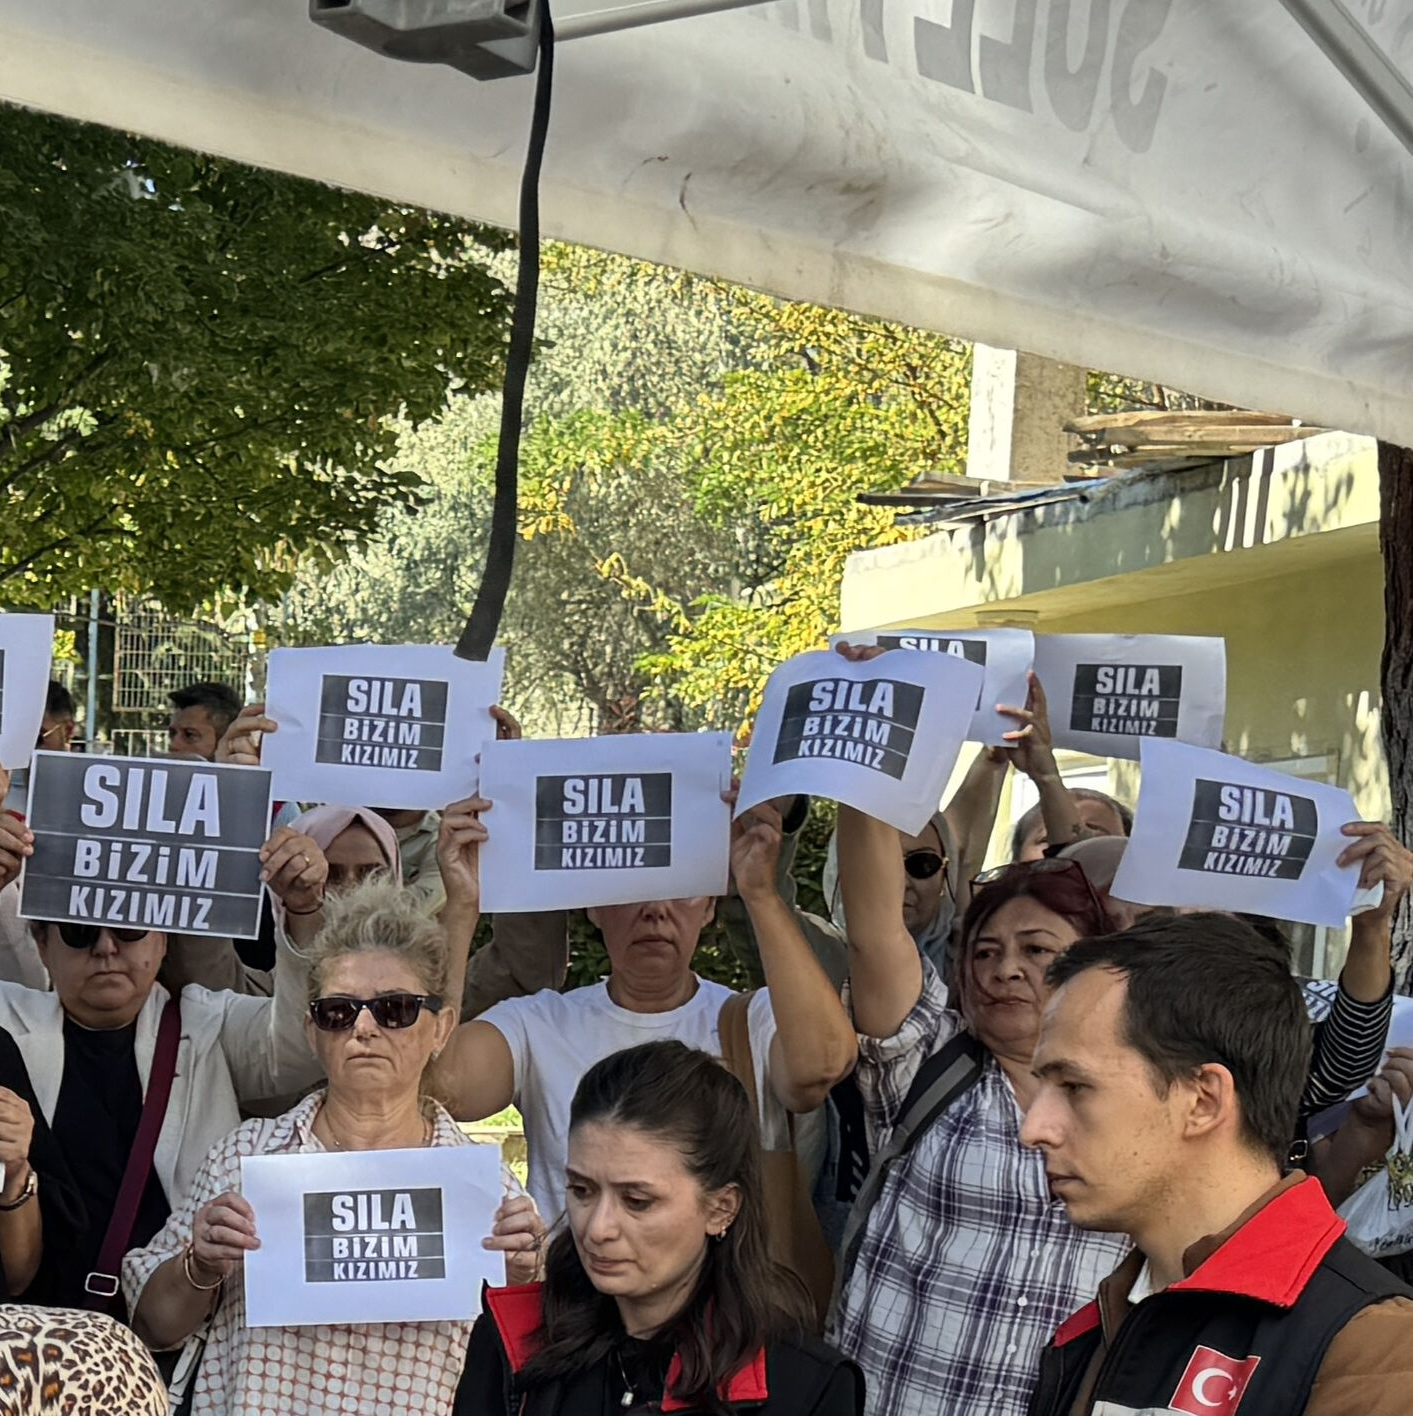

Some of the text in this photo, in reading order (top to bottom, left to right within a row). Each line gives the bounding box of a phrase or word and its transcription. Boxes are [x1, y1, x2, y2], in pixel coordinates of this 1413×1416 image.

[347, 679, 423, 717] SILA
[1095, 667, 1160, 695] SILA
[809, 680, 894, 718] SILA
[1091, 718, 1156, 734] KIZIMIZ
[341, 743, 418, 768] KIZIMIZ
[798, 737, 886, 770] KIZIMIZ
[80, 764, 221, 837] SILA
[563, 778, 645, 815] SILA
[1219, 785, 1295, 829] SILA
[561, 845, 645, 868] KIZIMIZ
[1204, 850, 1283, 878] KIZIMIZ
[69, 885, 213, 930] KIZIMIZ
[331, 1192, 416, 1232] SILA
[333, 1258, 418, 1282] KIZIMIZ
